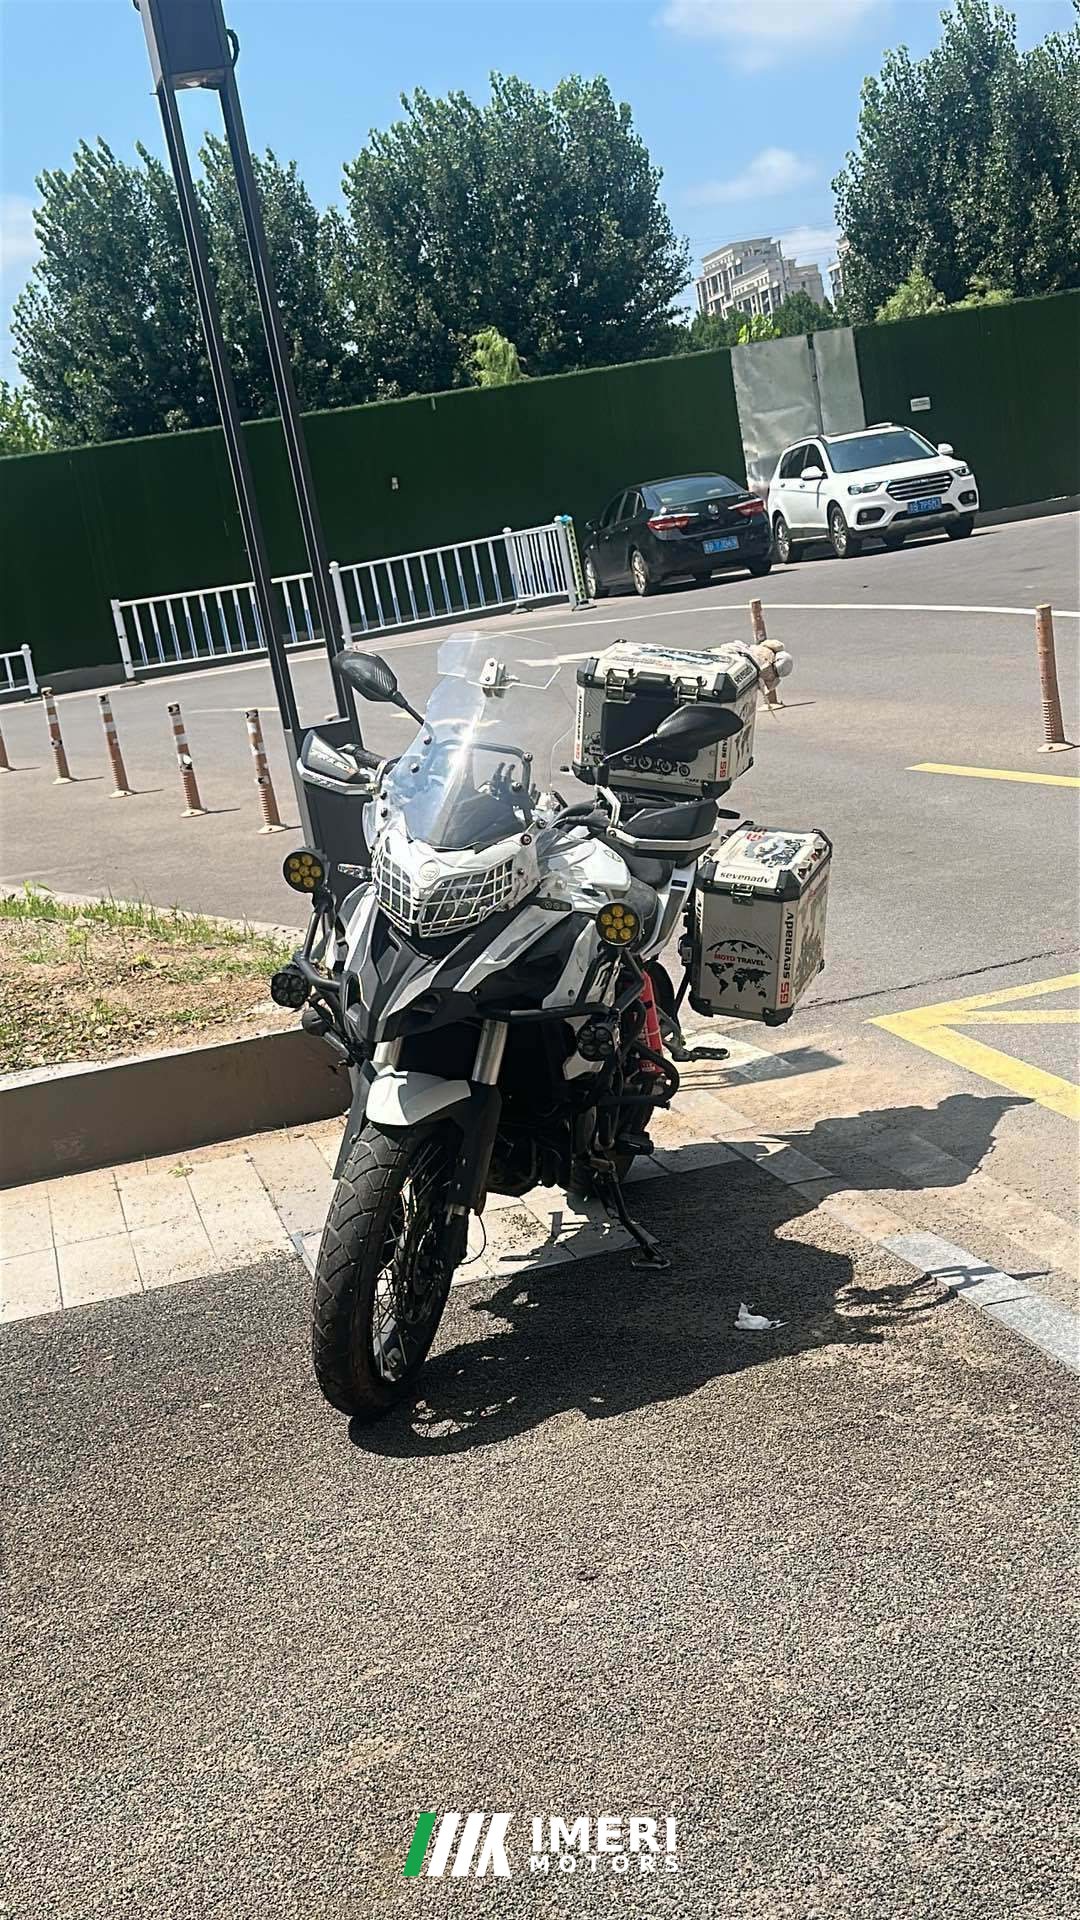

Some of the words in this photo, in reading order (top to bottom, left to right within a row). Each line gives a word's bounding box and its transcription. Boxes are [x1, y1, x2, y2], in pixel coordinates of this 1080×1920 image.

[720, 871, 770, 884] sevenadv
[783, 912, 794, 978] sevenadv
[737, 956, 766, 966] TRAVEL
[780, 982, 789, 1004] GS
